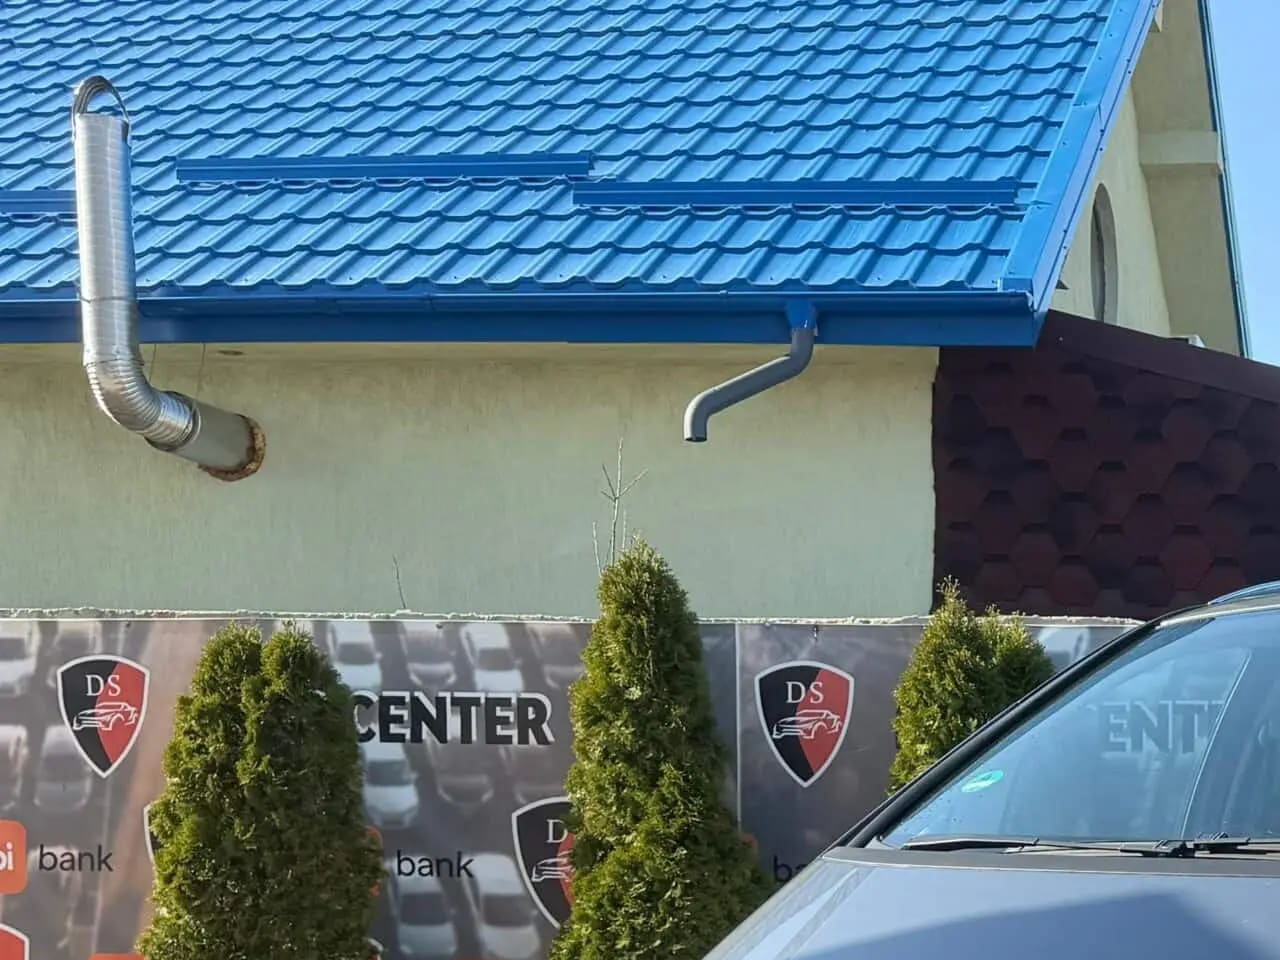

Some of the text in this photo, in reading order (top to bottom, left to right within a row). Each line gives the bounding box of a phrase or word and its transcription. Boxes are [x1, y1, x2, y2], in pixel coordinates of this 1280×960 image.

[86, 675, 121, 697] DS
[787, 681, 825, 704] DS
[351, 691, 555, 745] CENTER
[39, 844, 113, 872] bank
[397, 849, 475, 877] bank
